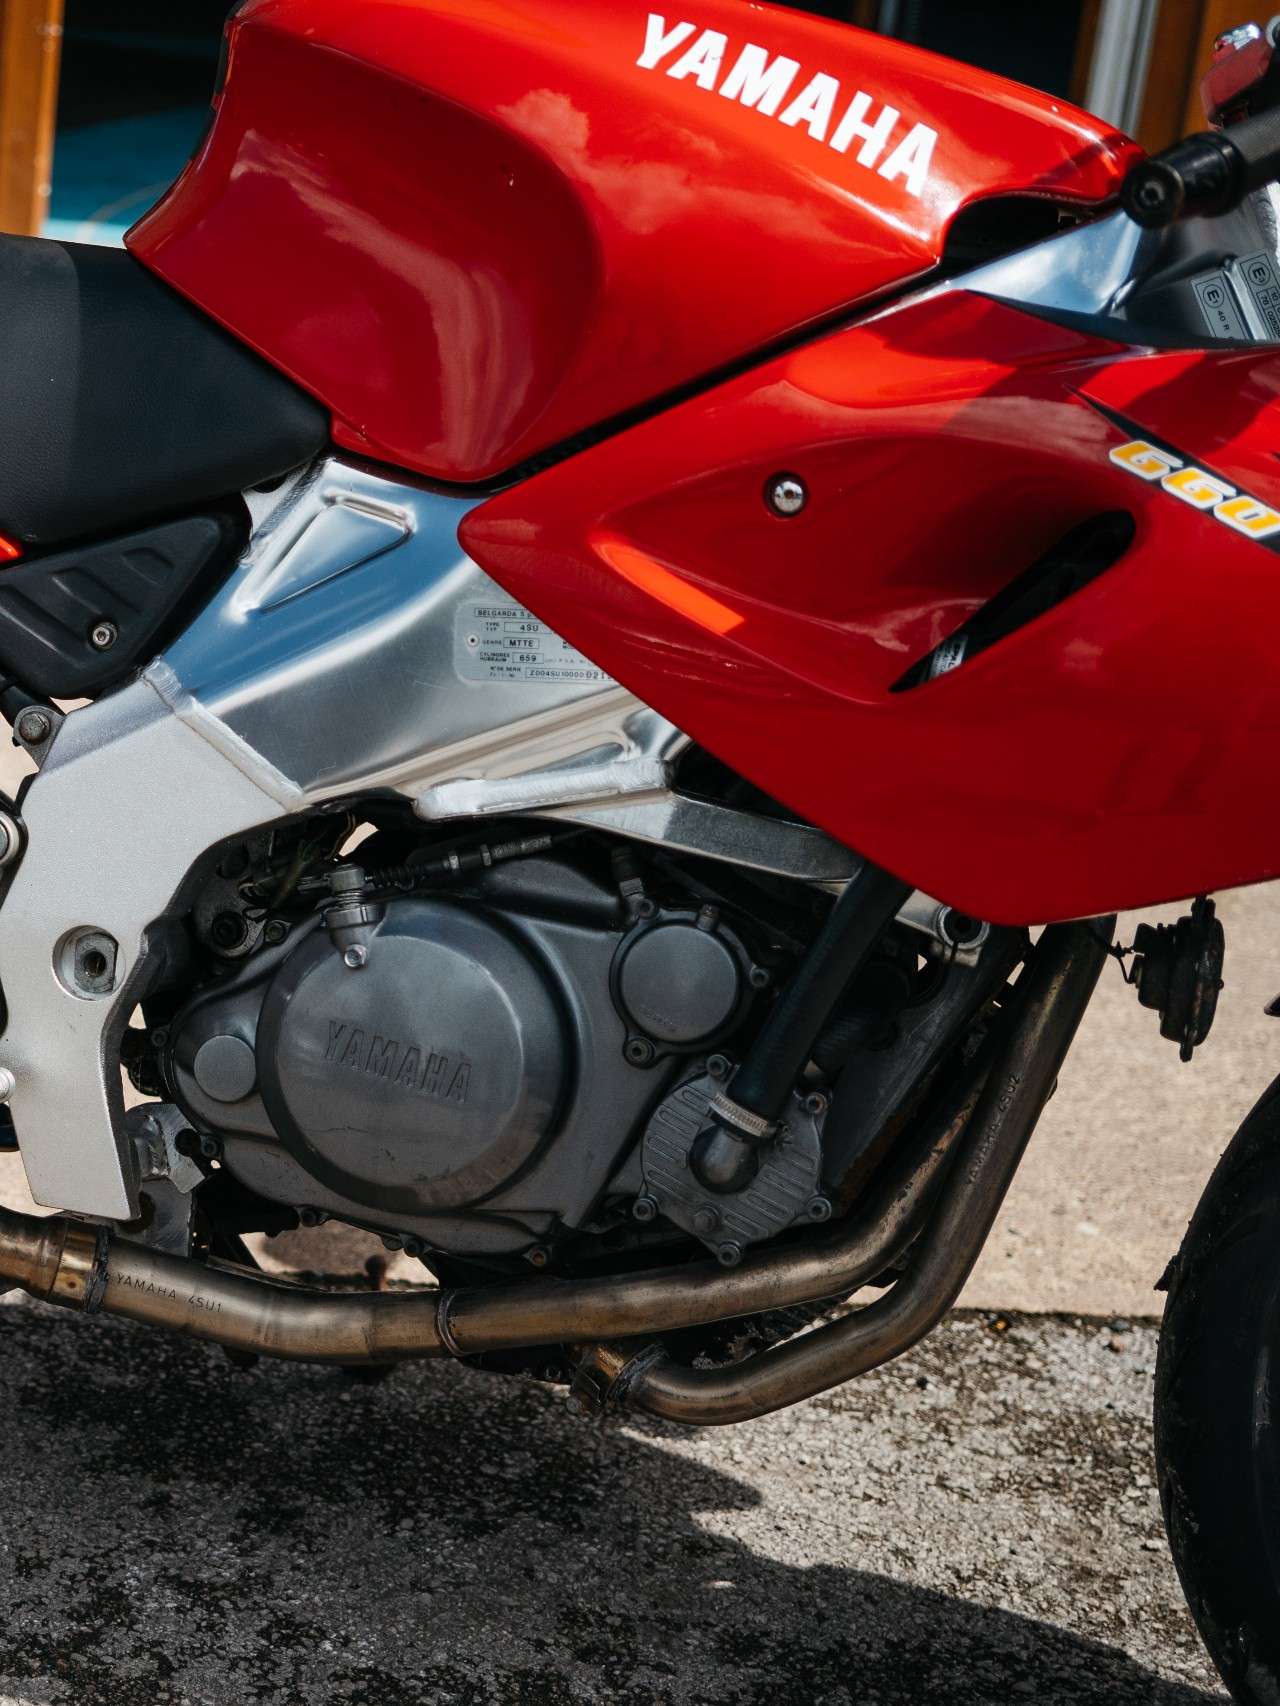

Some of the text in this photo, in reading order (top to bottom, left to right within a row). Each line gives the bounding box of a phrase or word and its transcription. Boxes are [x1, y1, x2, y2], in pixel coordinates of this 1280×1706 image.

[636, 13, 939, 197] YAMAHA
[1109, 440, 1280, 539] 660
[477, 609, 517, 617] BELGARDA
[520, 623, 539, 632] 4SU
[509, 639, 534, 647] MTTE
[324, 1020, 472, 1101] YAMAHA
[117, 1271, 223, 1312] YAMAHA 4SU1
